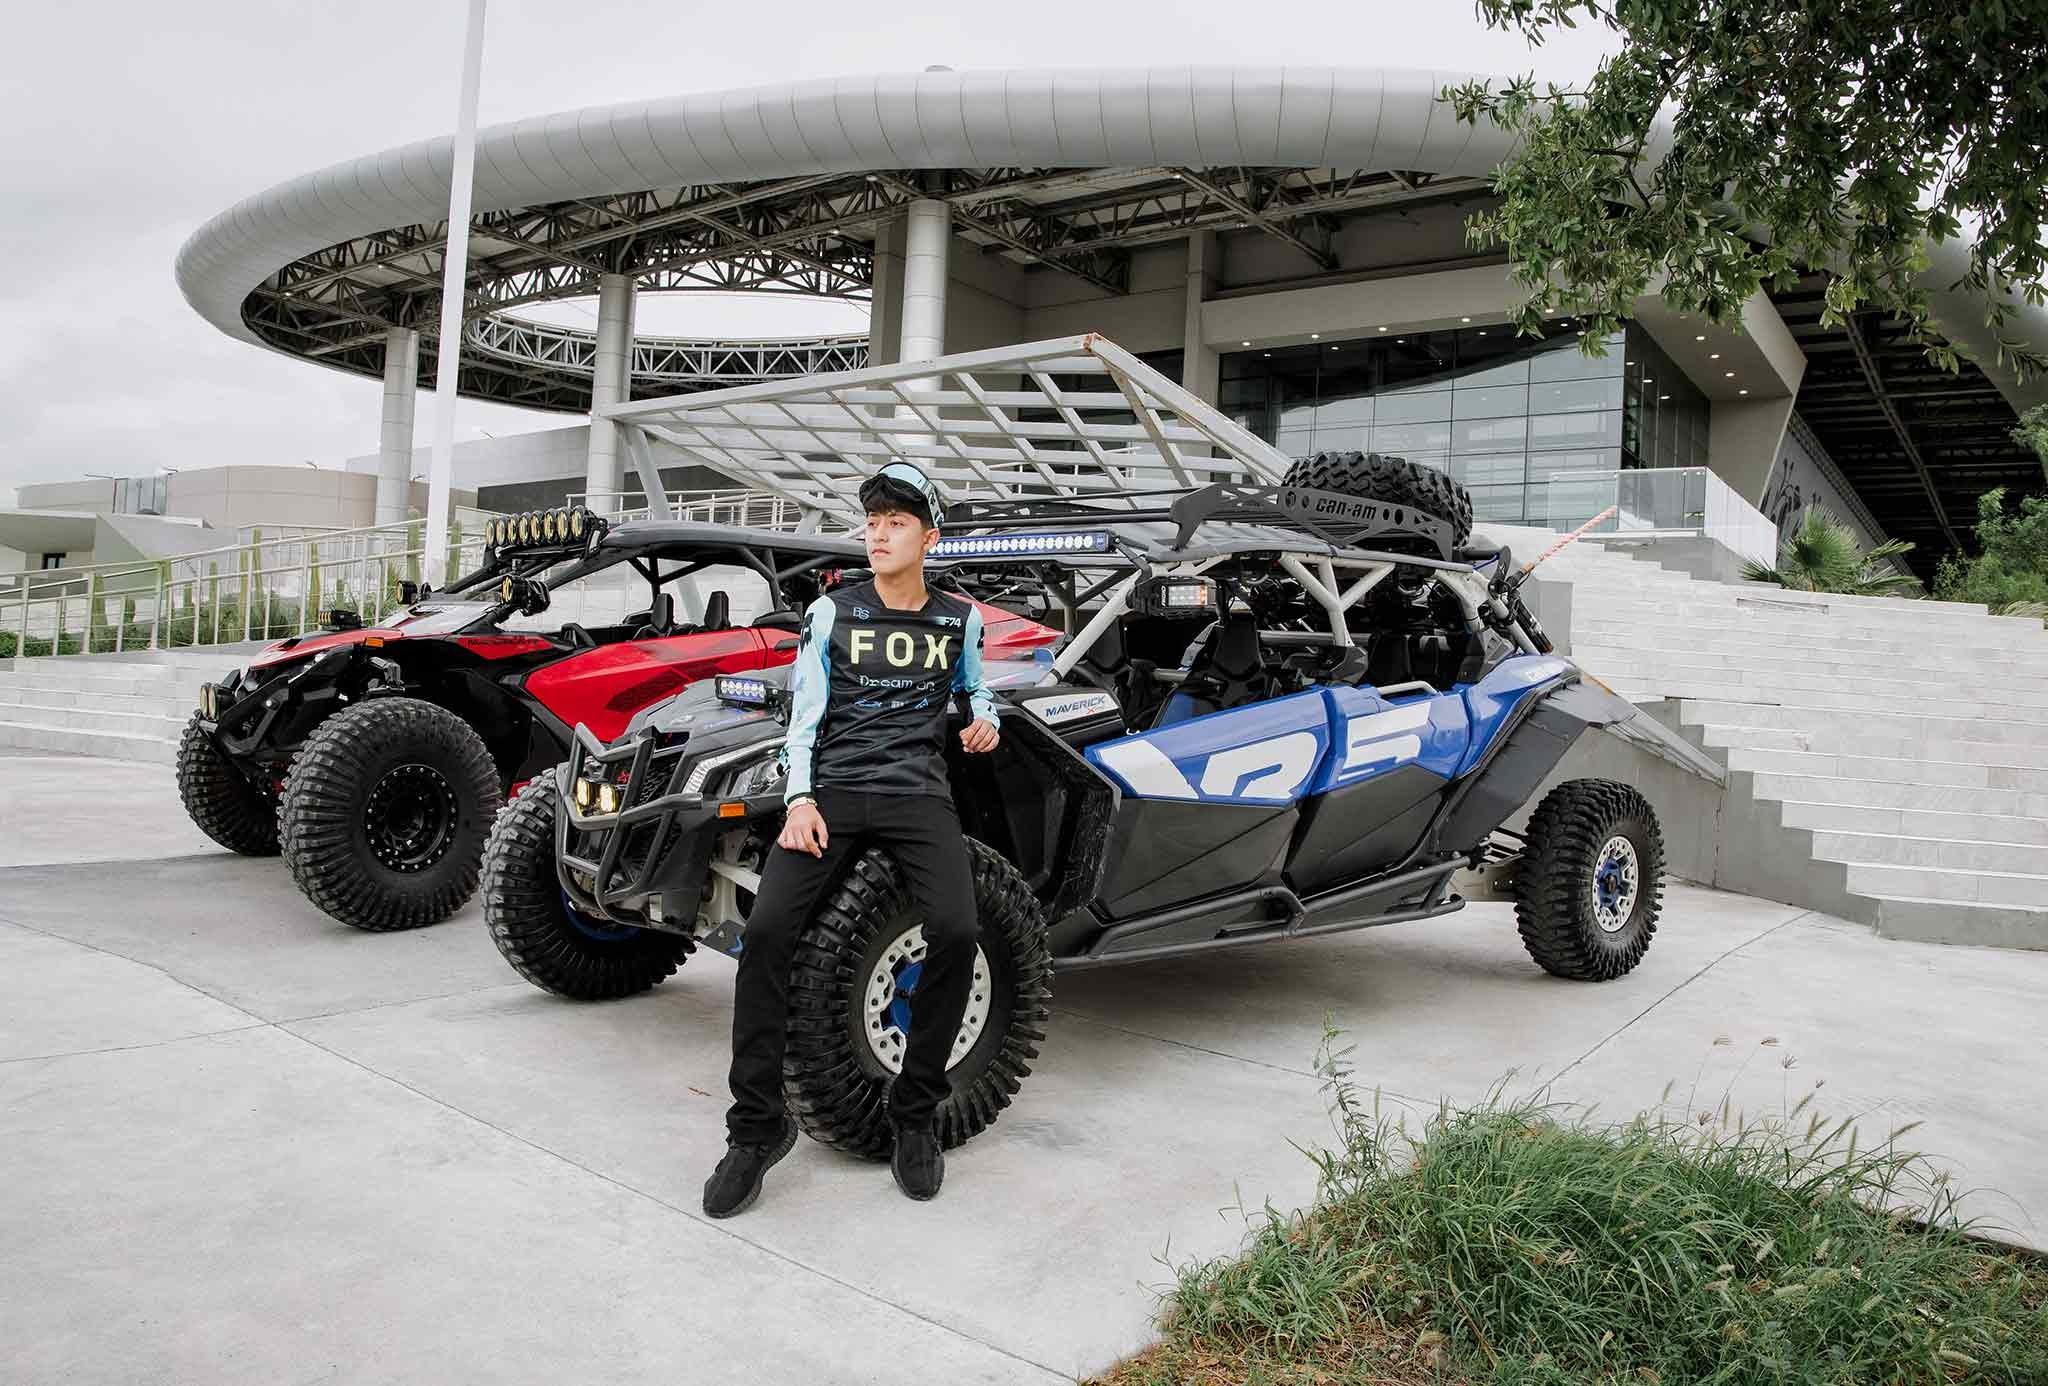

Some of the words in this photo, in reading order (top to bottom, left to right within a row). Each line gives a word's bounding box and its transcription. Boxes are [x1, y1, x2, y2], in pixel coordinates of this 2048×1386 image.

[1315, 497, 1378, 521] can-am
[849, 629, 953, 670] FOX
[1045, 695, 1106, 717] MAVERICK
